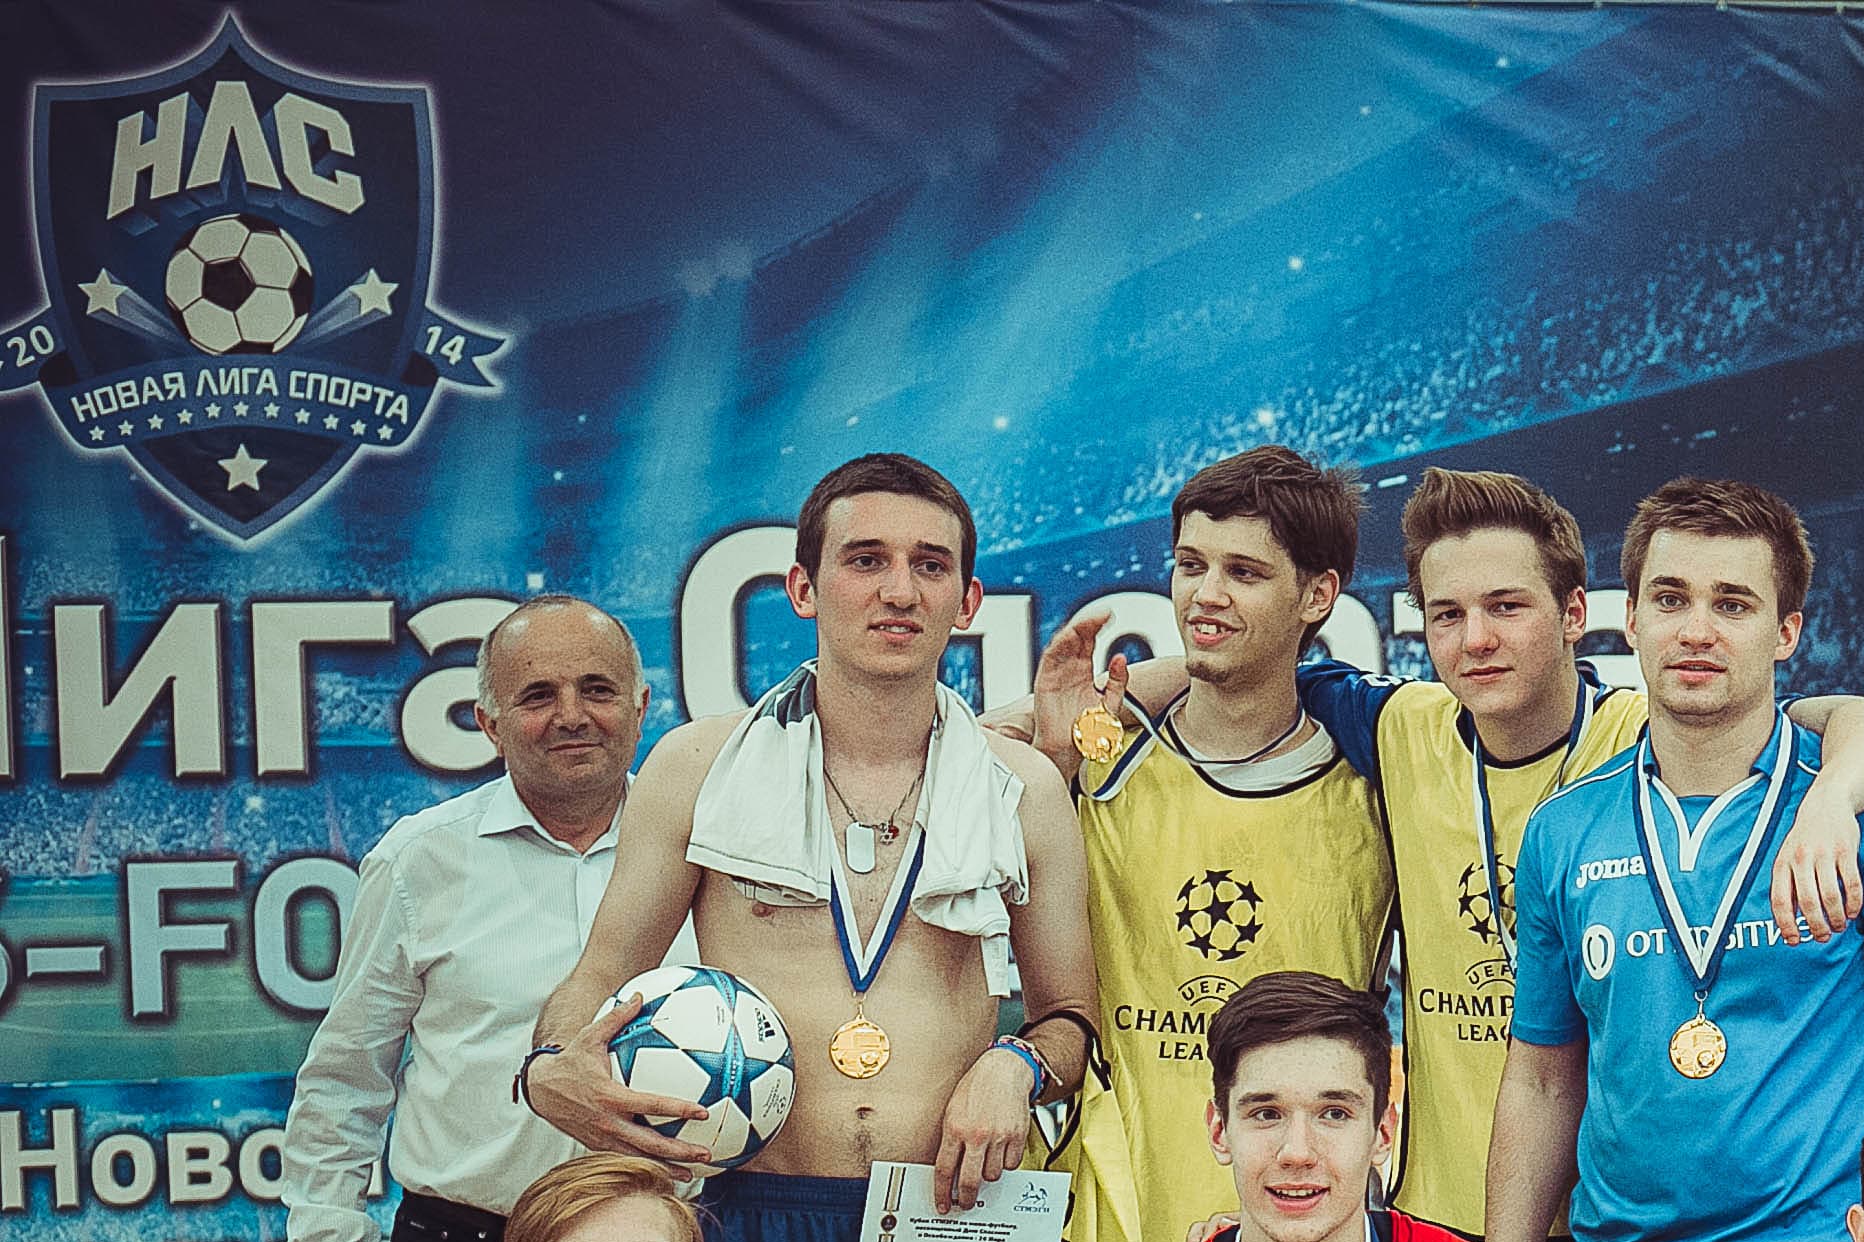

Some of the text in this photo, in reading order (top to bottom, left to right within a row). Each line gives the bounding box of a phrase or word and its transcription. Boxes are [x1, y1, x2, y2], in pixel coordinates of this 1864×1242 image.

[107, 80, 366, 220] НЛС
[6, 324, 465, 368] 20 14
[71, 366, 410, 425] НОВАЯ ЛИГА СПОРТА
[0, 535, 520, 780] ига
[1469, 964, 1512, 985] UEF
